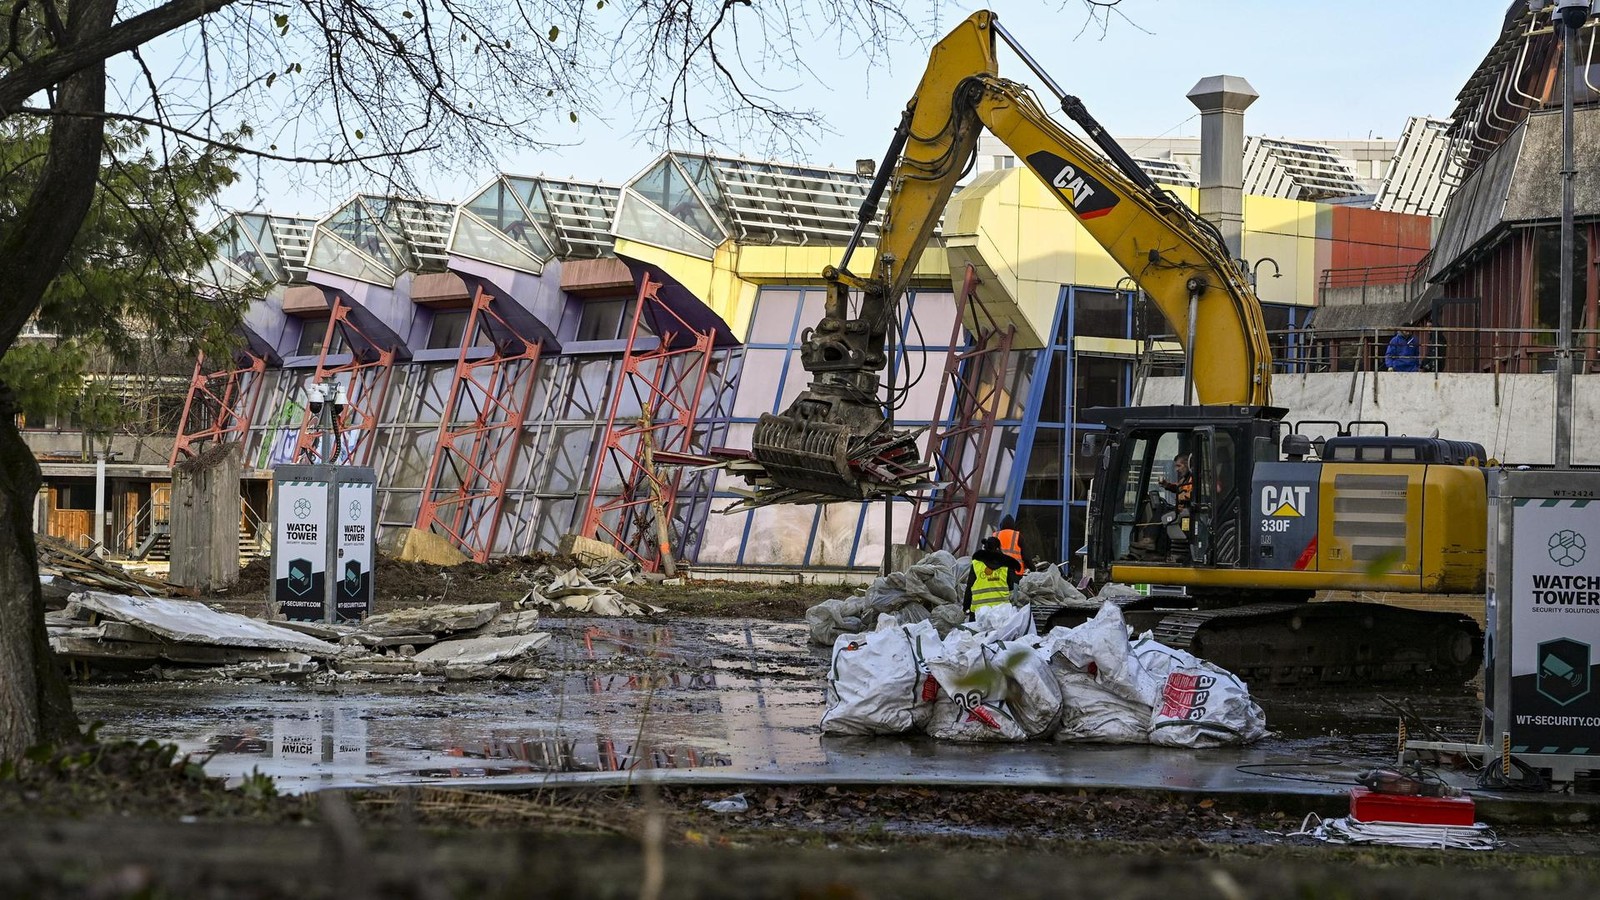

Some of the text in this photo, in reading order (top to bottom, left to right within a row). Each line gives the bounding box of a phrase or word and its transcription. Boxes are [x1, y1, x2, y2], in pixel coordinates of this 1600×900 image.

[1053, 165, 1095, 208] CAT
[1261, 485, 1310, 517] CAT
[286, 523, 317, 532] WATCH
[344, 525, 365, 533] WATCH
[1261, 519, 1290, 532] 330F
[286, 532, 317, 541] TOWER
[344, 533, 365, 542] TOWER
[1532, 575, 1600, 590] WATCH
[1532, 591, 1600, 606] TOWER
